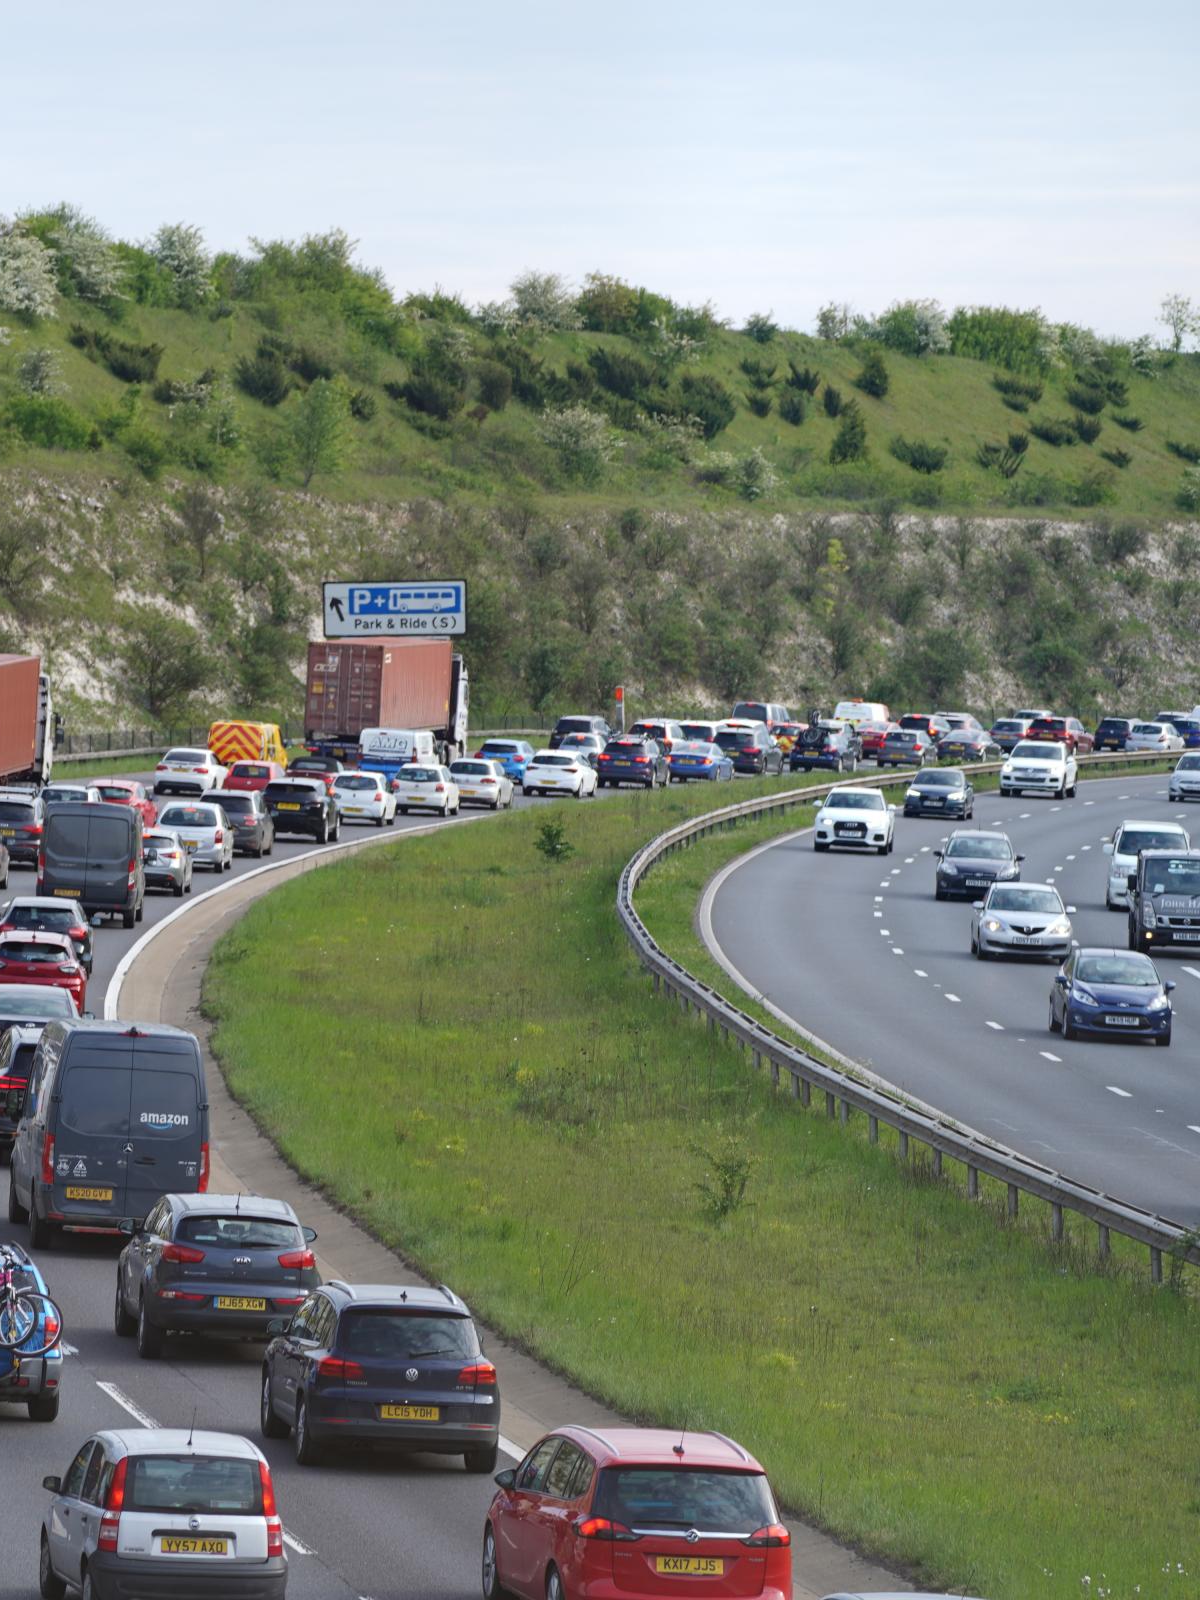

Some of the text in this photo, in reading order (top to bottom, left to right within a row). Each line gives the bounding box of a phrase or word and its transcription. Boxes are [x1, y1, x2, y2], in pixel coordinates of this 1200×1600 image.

[354, 617, 382, 630] Park
[387, 618, 395, 629] &
[400, 617, 427, 630] Ride
[139, 1112, 189, 1126] amazon
[219, 1297, 243, 1309] HJ65
[166, 1540, 198, 1552] YY57
[662, 1558, 716, 1571] KX17 JJS
